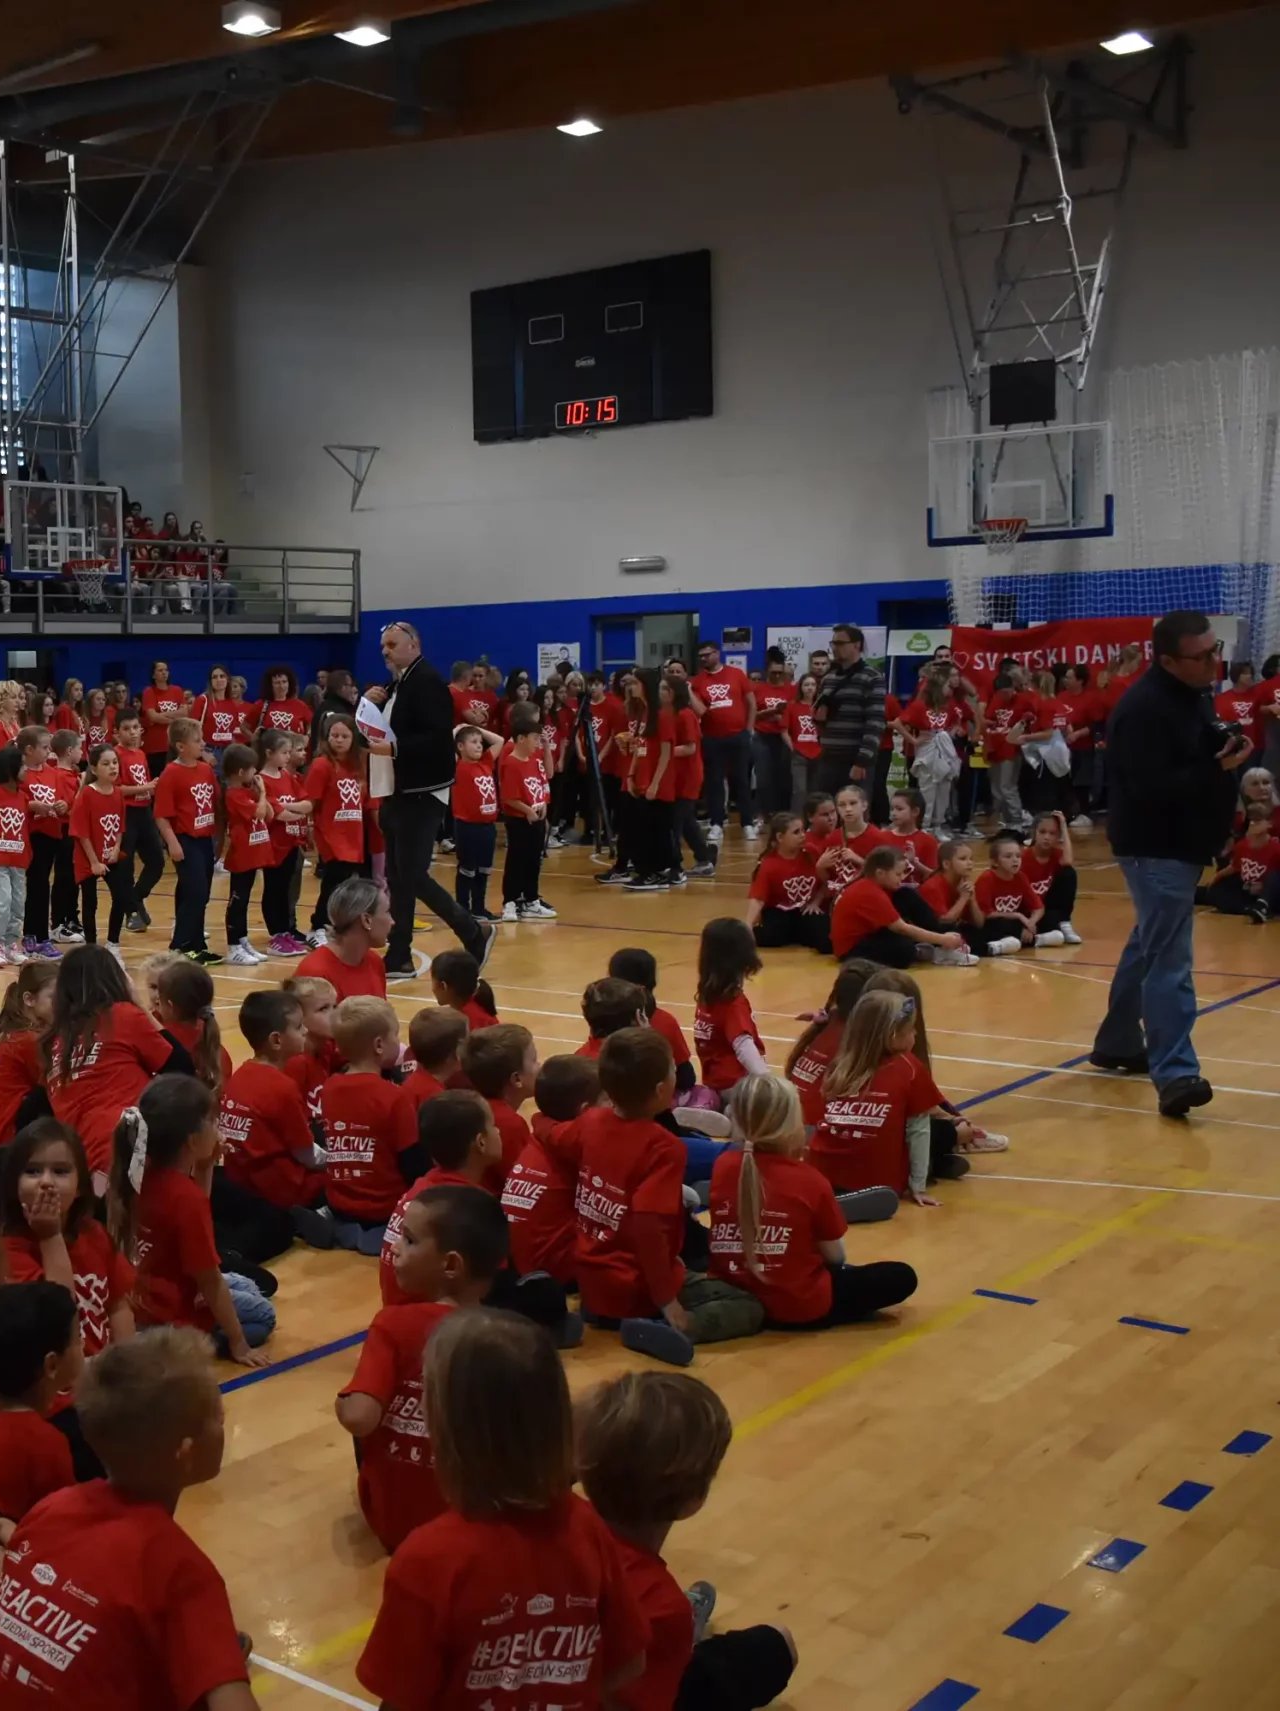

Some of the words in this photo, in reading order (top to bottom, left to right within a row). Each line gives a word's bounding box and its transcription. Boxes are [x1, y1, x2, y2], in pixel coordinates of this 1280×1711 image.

[566, 398, 615, 425] 10:15
[327, 1136, 376, 1151] EACTIVE
[29, 1637, 67, 1665] SPORTA
